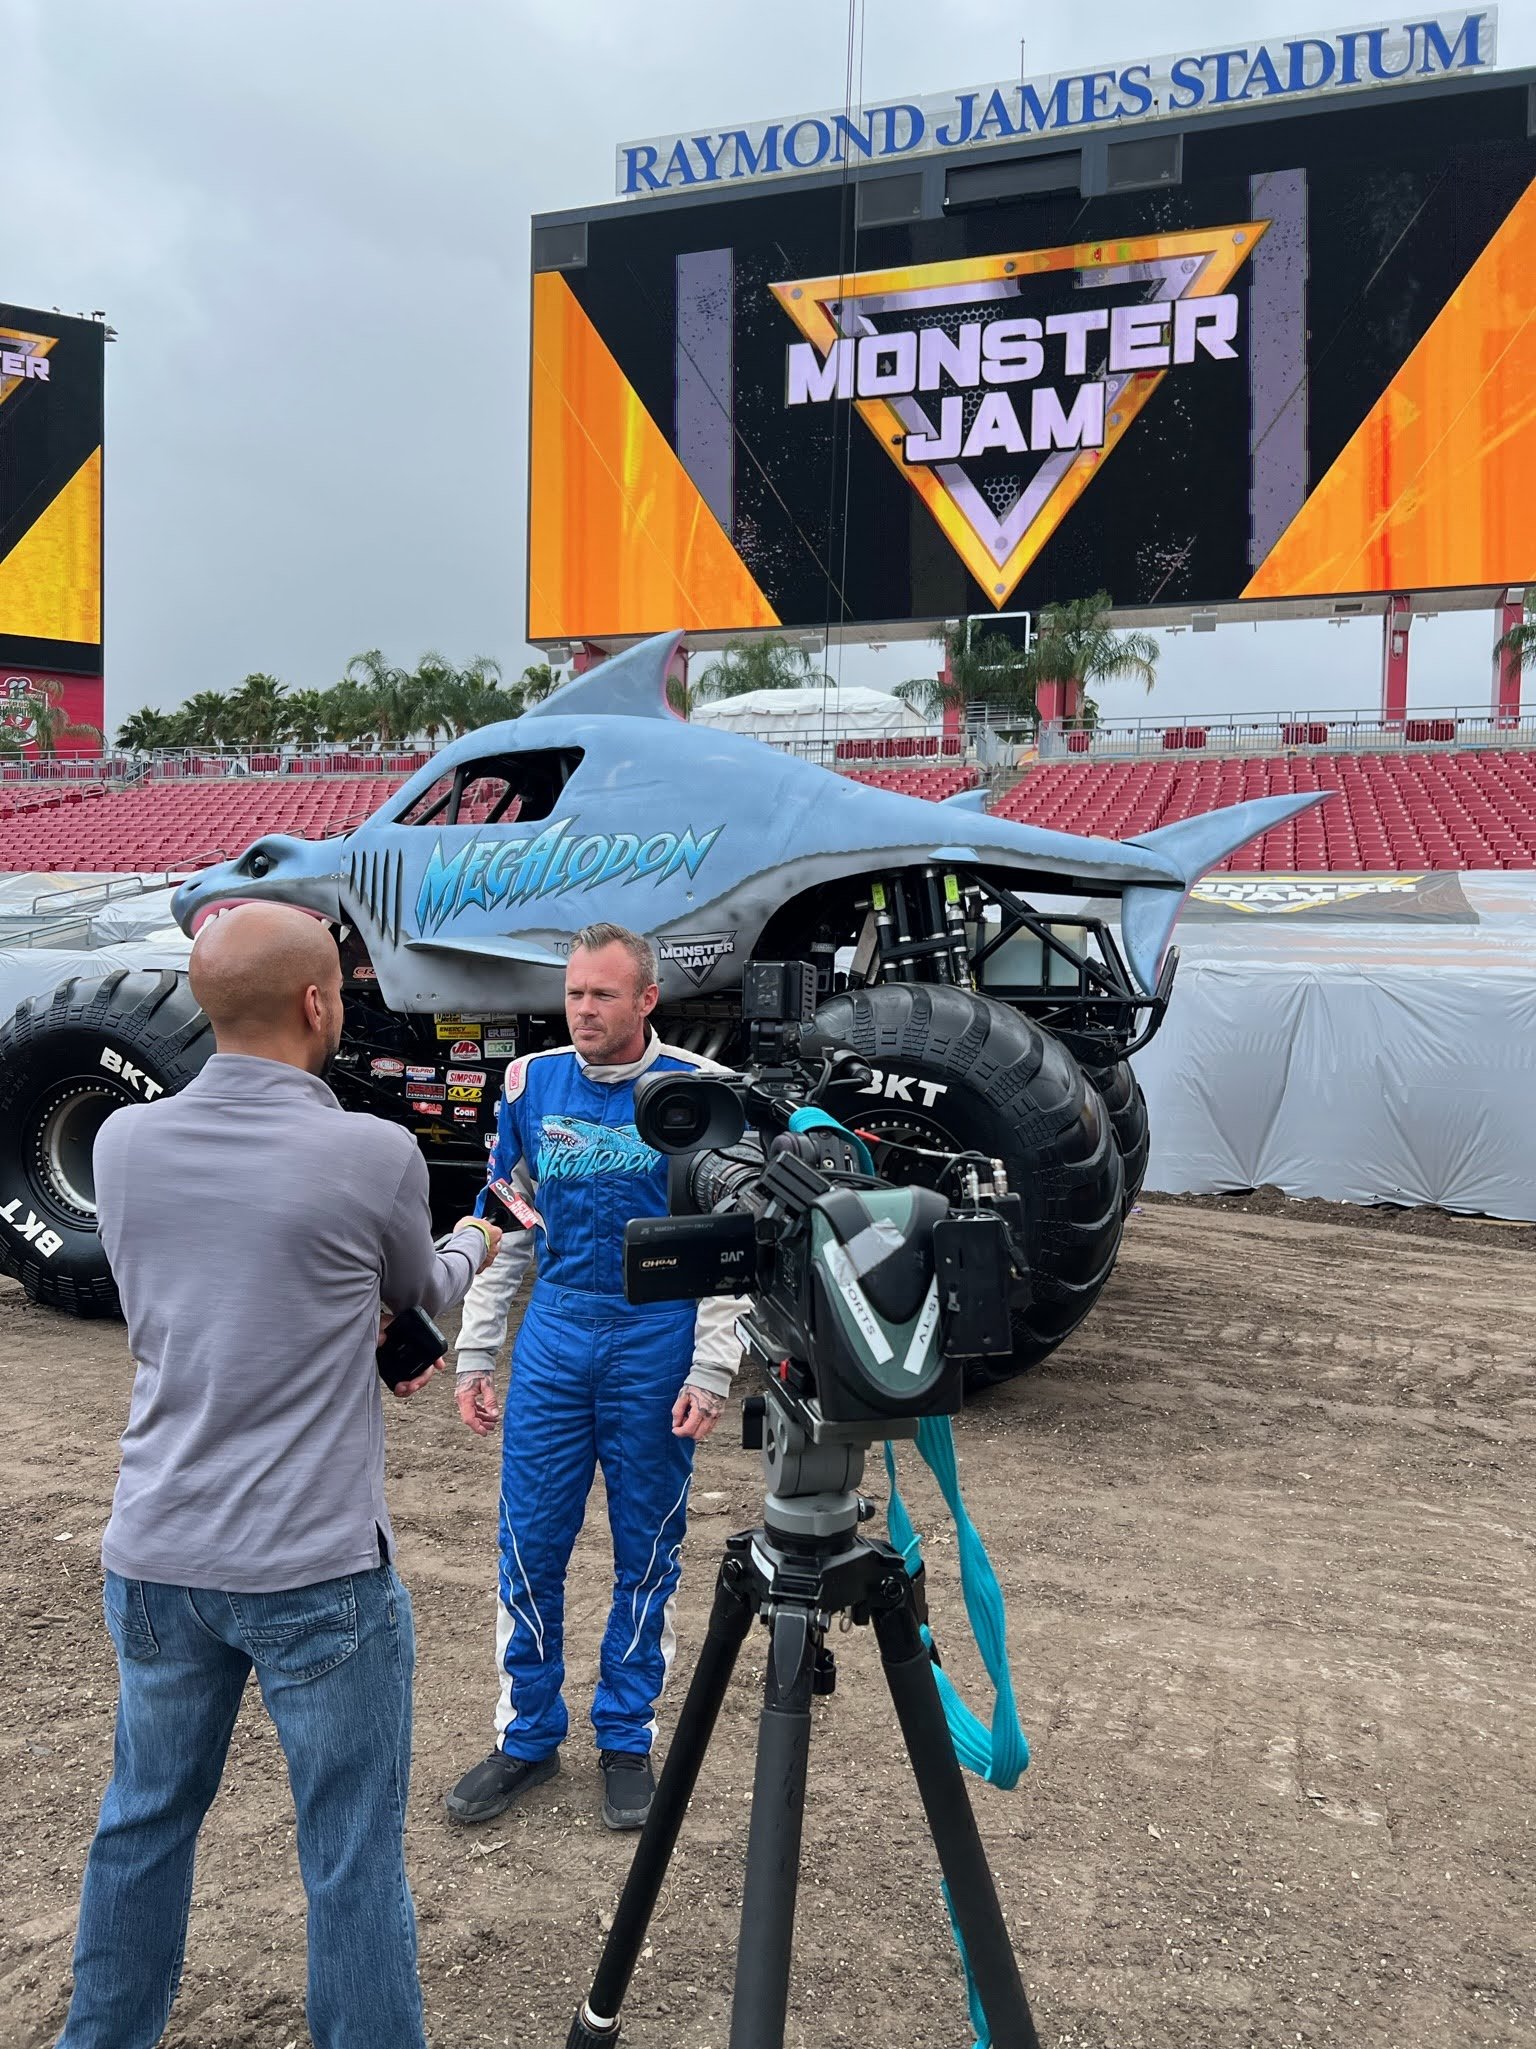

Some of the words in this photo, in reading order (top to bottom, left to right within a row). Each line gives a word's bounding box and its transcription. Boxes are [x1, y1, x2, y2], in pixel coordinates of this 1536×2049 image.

[620, 104, 926, 194] RAYMOND
[935, 64, 1152, 147] JAMES
[1169, 12, 1488, 107] STADIUM
[787, 294, 1240, 406] MONSTER
[0, 350, 50, 381] ER
[905, 381, 1105, 462] JAM
[415, 814, 727, 937] MEGALODON
[1226, 891, 1336, 901] JAM
[554, 942, 569, 954] TO
[659, 942, 735, 959] MONSTER
[683, 955, 715, 968] JAM
[487, 1042, 513, 1053] BKT
[100, 1046, 163, 1101] BKT
[449, 1072, 483, 1084] SIMPSON
[856, 1069, 948, 1107] BKT
[453, 1106, 476, 1117] Coan
[536, 1143, 662, 1186] MEGALODON
[495, 1182, 515, 1203] abc
[0, 1198, 63, 1258] BKT
[642, 1258, 678, 1268] ProHD
[720, 1250, 745, 1263] JVC
[846, 1281, 876, 1335] ORTS
